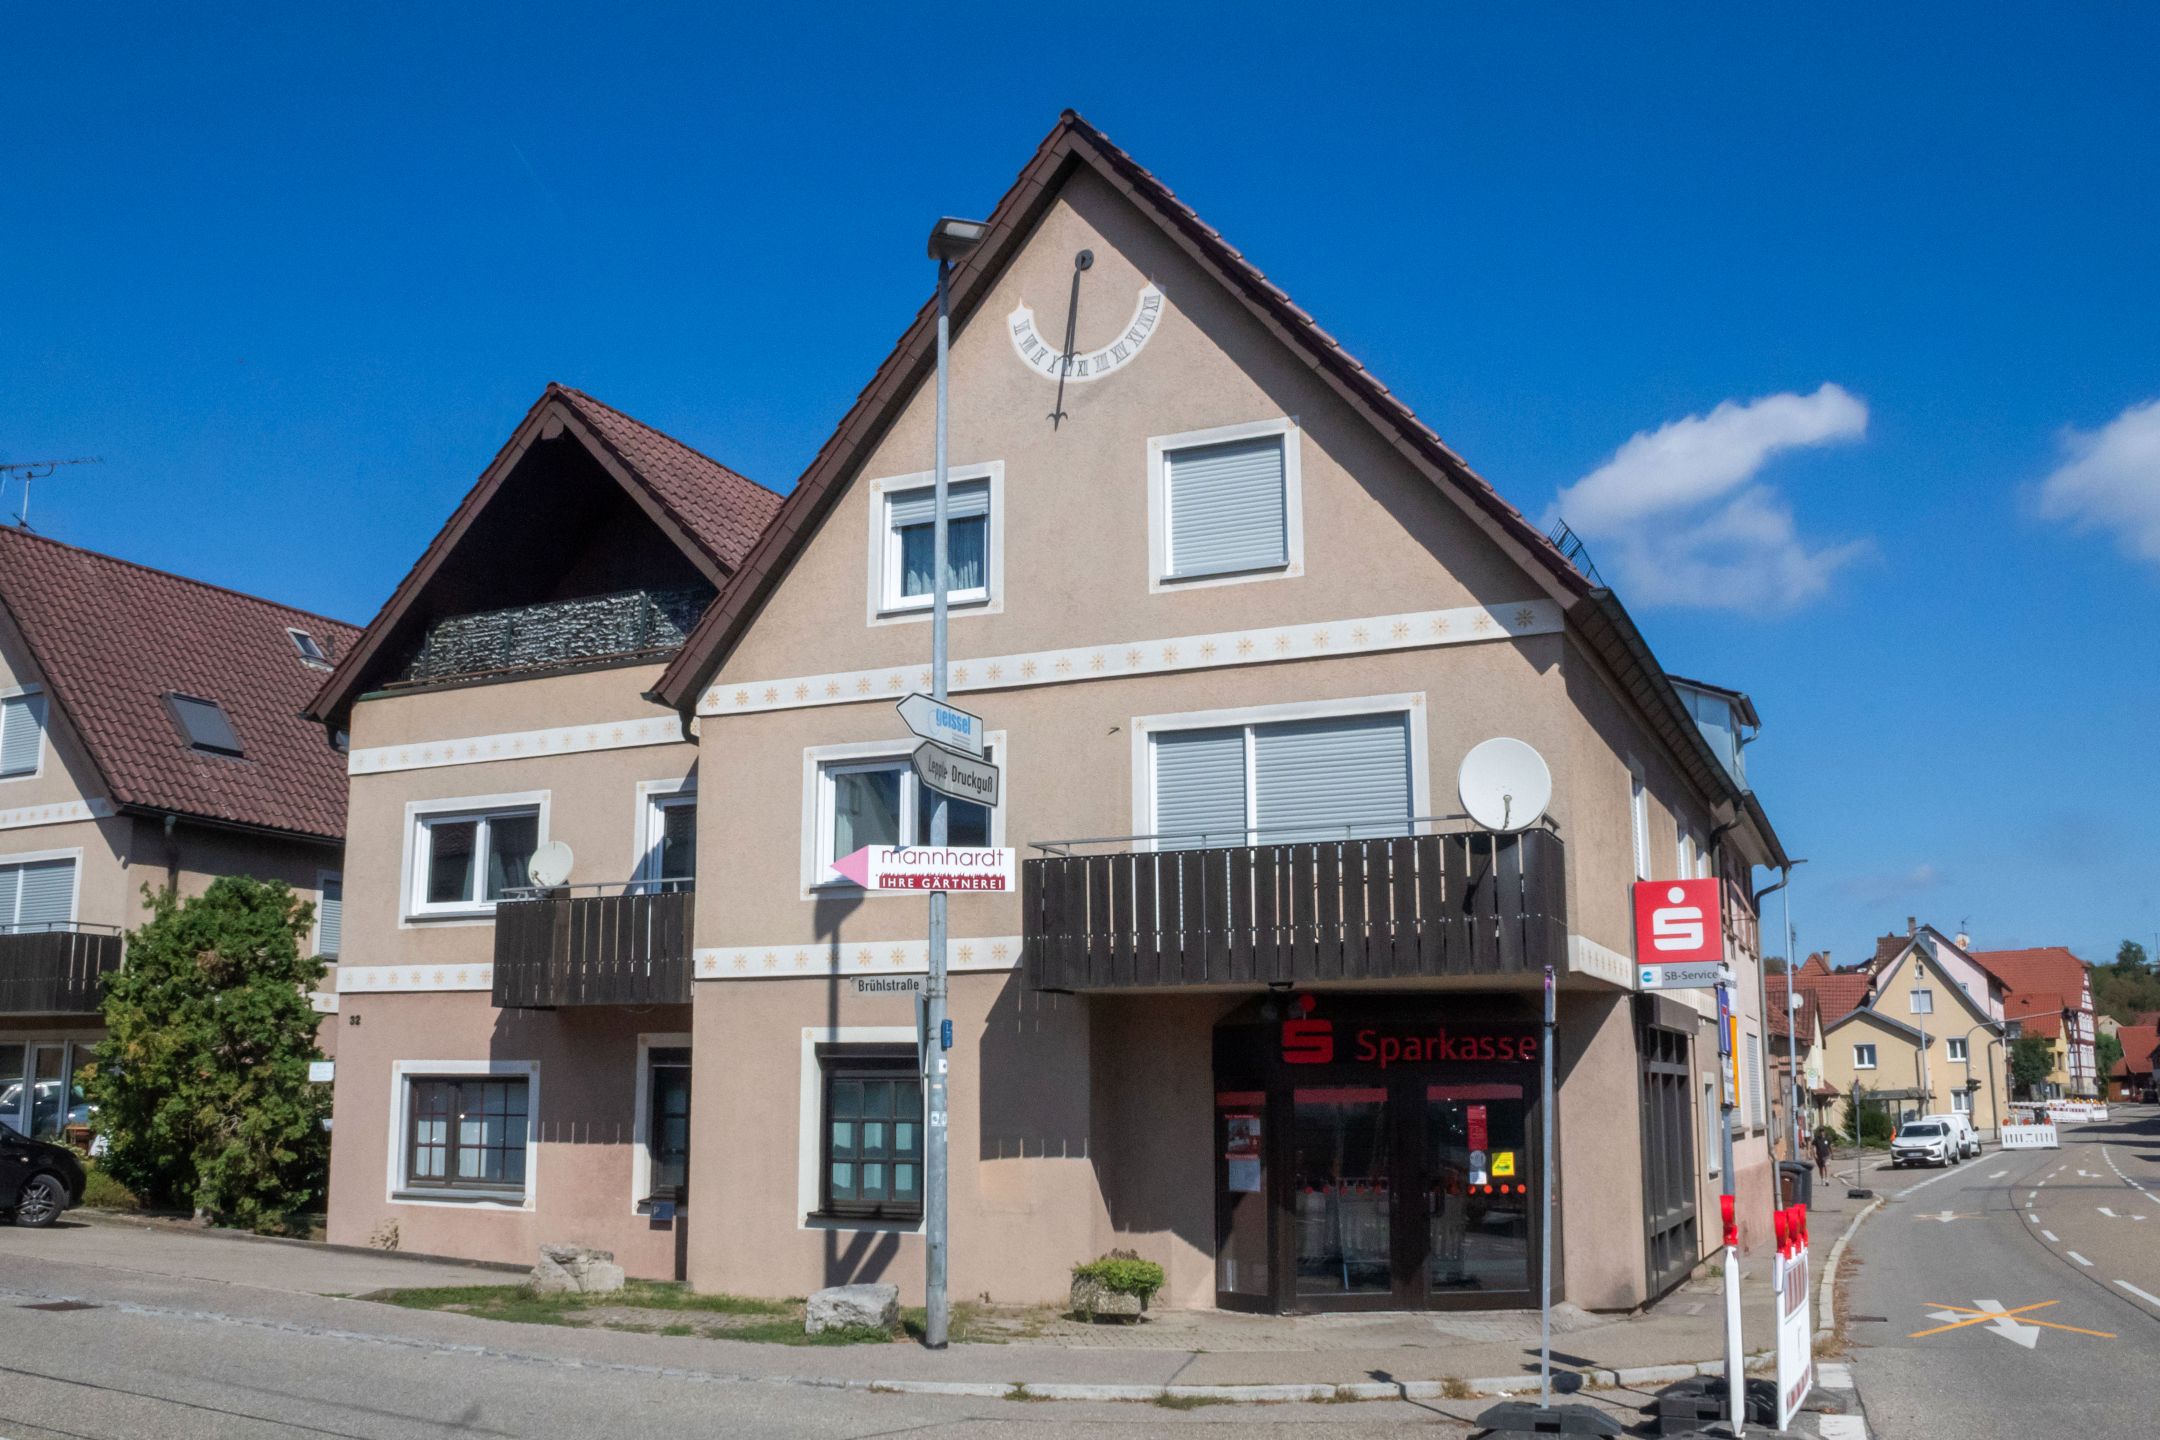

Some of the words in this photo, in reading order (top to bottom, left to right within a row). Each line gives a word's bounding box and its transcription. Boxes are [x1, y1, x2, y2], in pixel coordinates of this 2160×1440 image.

[951, 765, 993, 794] Druckguß
[881, 848, 1004, 866] mannhardt
[882, 878, 914, 888] IHRE
[921, 876, 1002, 889] GÄRTNEREI
[1664, 970, 1719, 981] SB-Service
[858, 978, 919, 992] Brühlstraße
[1355, 1028, 1537, 1069] Sparkasse
